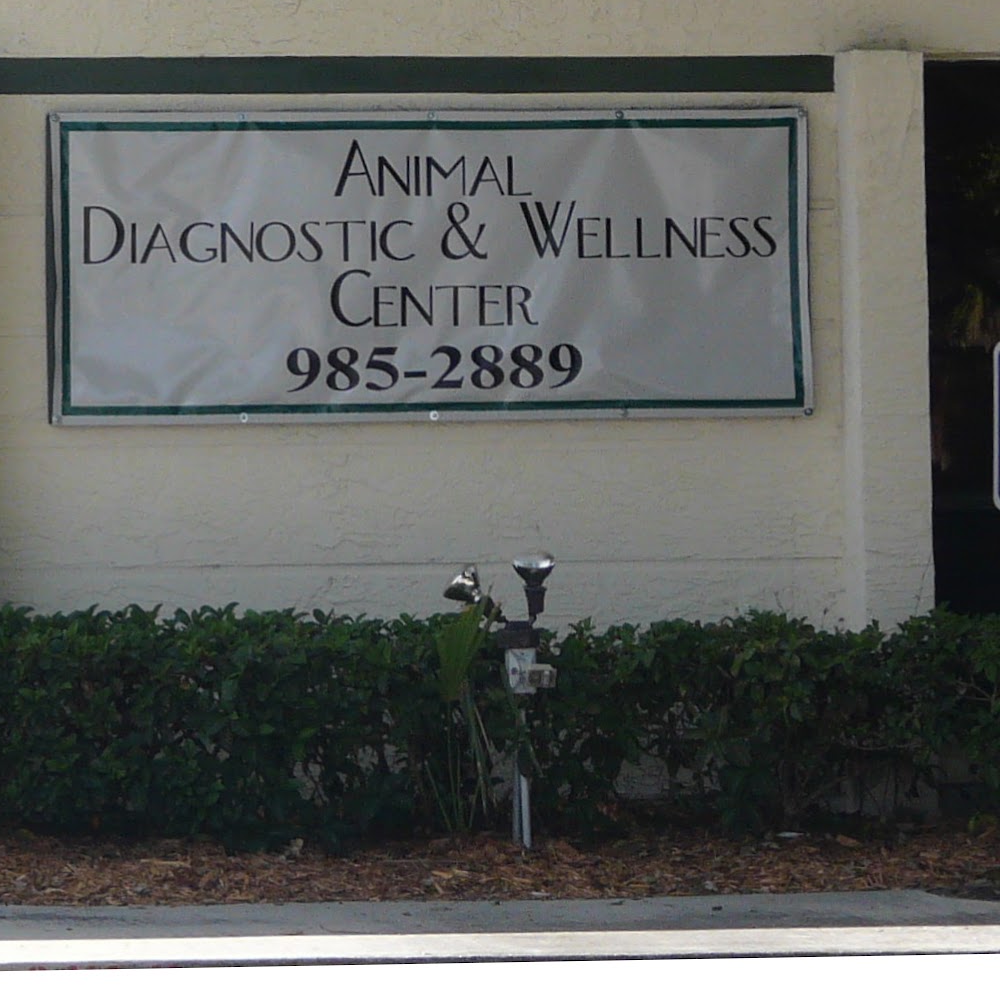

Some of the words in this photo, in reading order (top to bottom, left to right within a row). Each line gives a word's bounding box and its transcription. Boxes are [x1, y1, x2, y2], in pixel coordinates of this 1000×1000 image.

[333, 138, 534, 198] ANIMAL
[81, 205, 416, 265] DIAGNOSTIC
[440, 201, 489, 261] &
[517, 200, 778, 260] WELLNESS
[329, 268, 540, 328] CENTER
[286, 343, 583, 393] 985-2889
